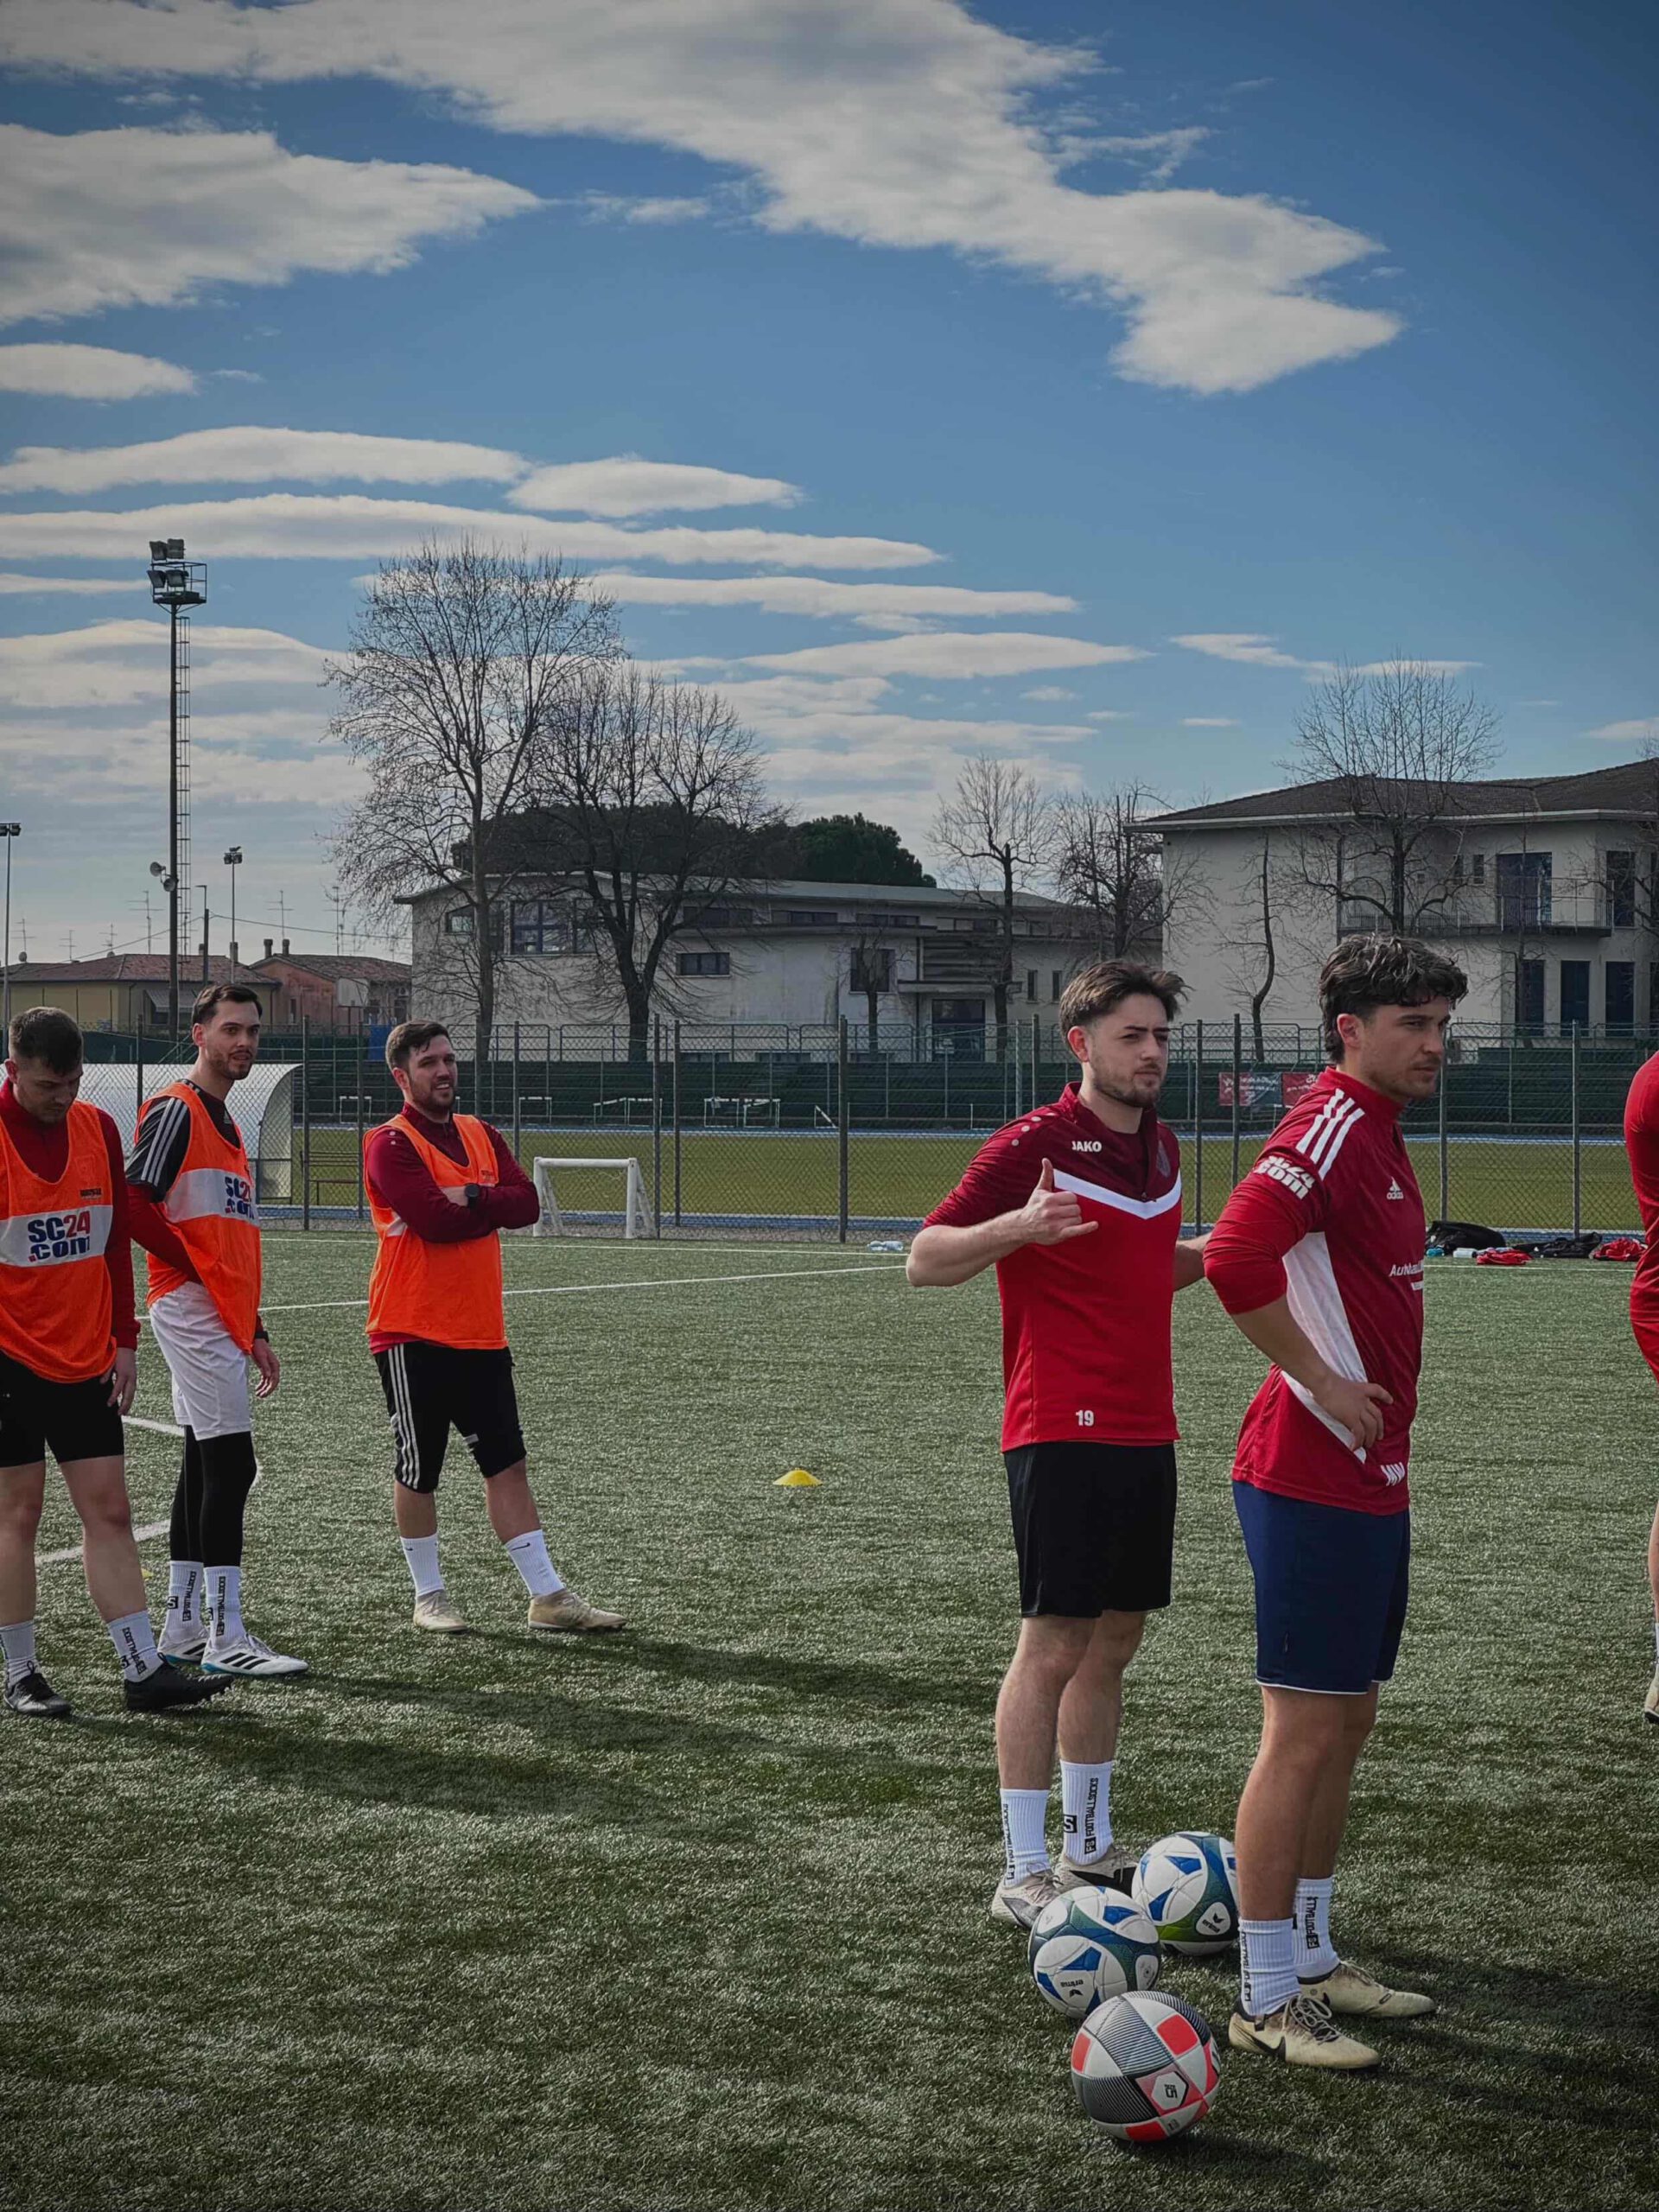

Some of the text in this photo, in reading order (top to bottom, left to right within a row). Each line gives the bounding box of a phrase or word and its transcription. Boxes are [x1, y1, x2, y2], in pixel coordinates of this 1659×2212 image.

[1071, 1140, 1103, 1153] JAKO
[28, 1211, 91, 1243] SC24
[29, 1236, 90, 1262] .com
[1075, 1409, 1095, 1427] 19
[1084, 1777, 1099, 1854] FS FOOTBALLSOCKS
[1306, 1934, 1320, 1949] FS
